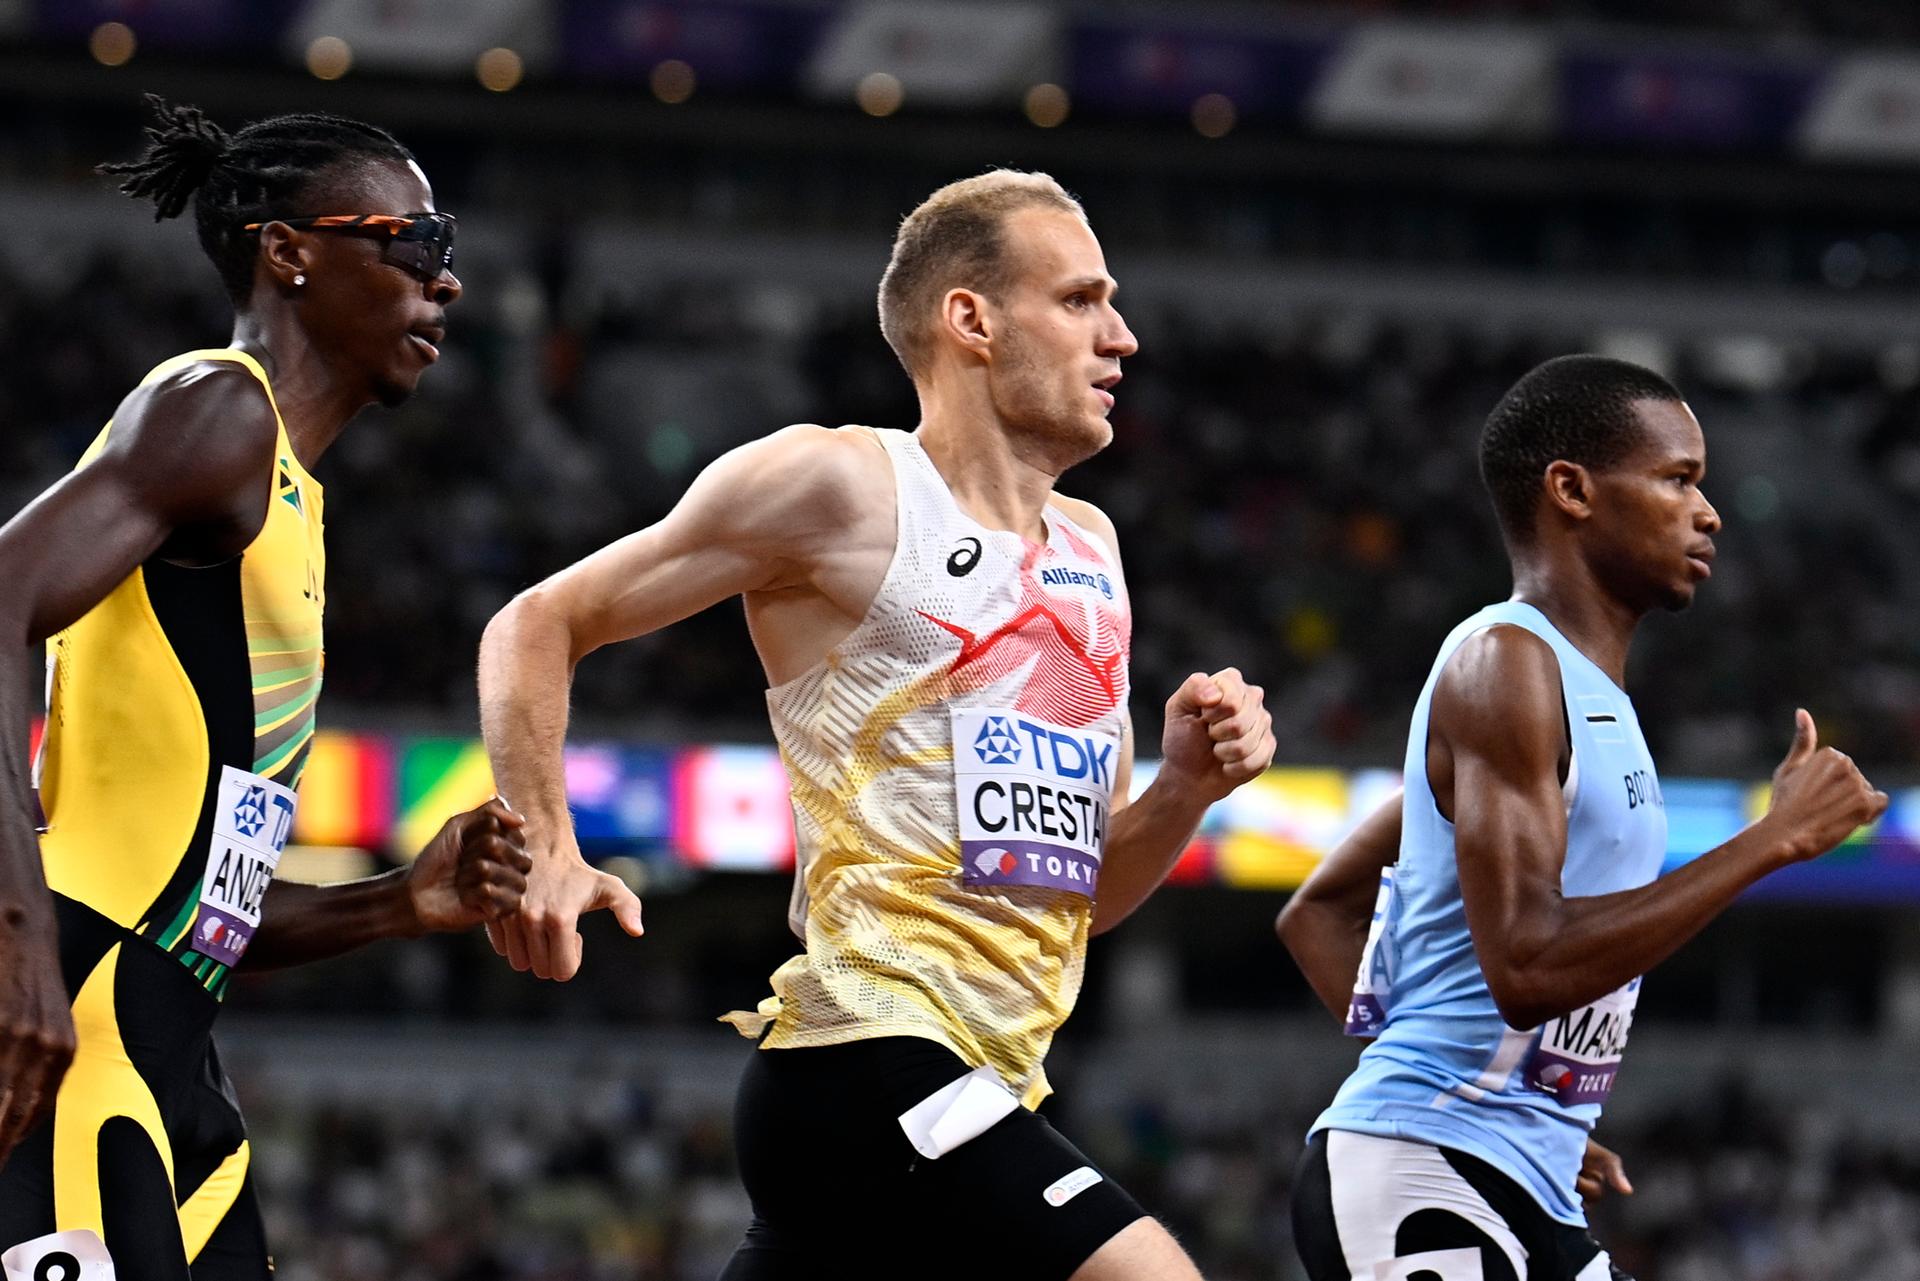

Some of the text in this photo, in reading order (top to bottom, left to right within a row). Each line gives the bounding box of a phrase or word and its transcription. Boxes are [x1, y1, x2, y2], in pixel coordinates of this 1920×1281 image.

[1041, 567, 1098, 589] Allianz
[1018, 719, 1113, 792] TDK
[1026, 852, 1097, 884] TOKY
